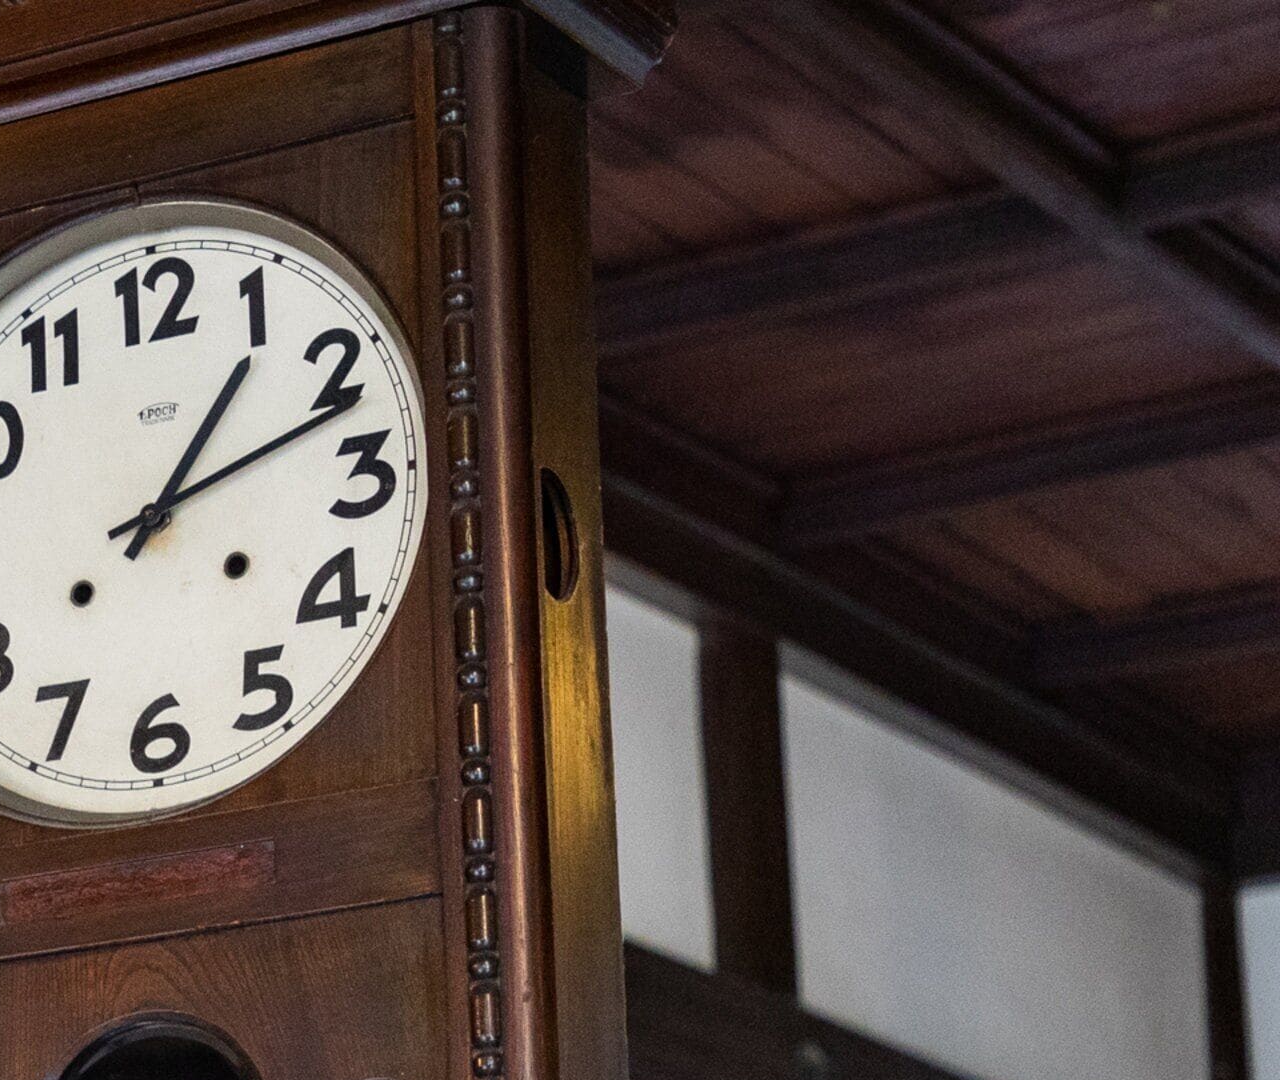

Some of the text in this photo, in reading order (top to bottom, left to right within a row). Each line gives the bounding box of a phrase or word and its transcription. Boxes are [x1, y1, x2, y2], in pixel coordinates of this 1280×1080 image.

[114, 257, 198, 348] 12
[239, 265, 267, 348] 1
[20, 307, 80, 394] 11
[303, 327, 365, 411] 2
[328, 430, 397, 520] 3
[296, 547, 371, 629] 4
[35, 679, 91, 761] 7
[232, 644, 294, 731] 5
[129, 693, 191, 774] 6
